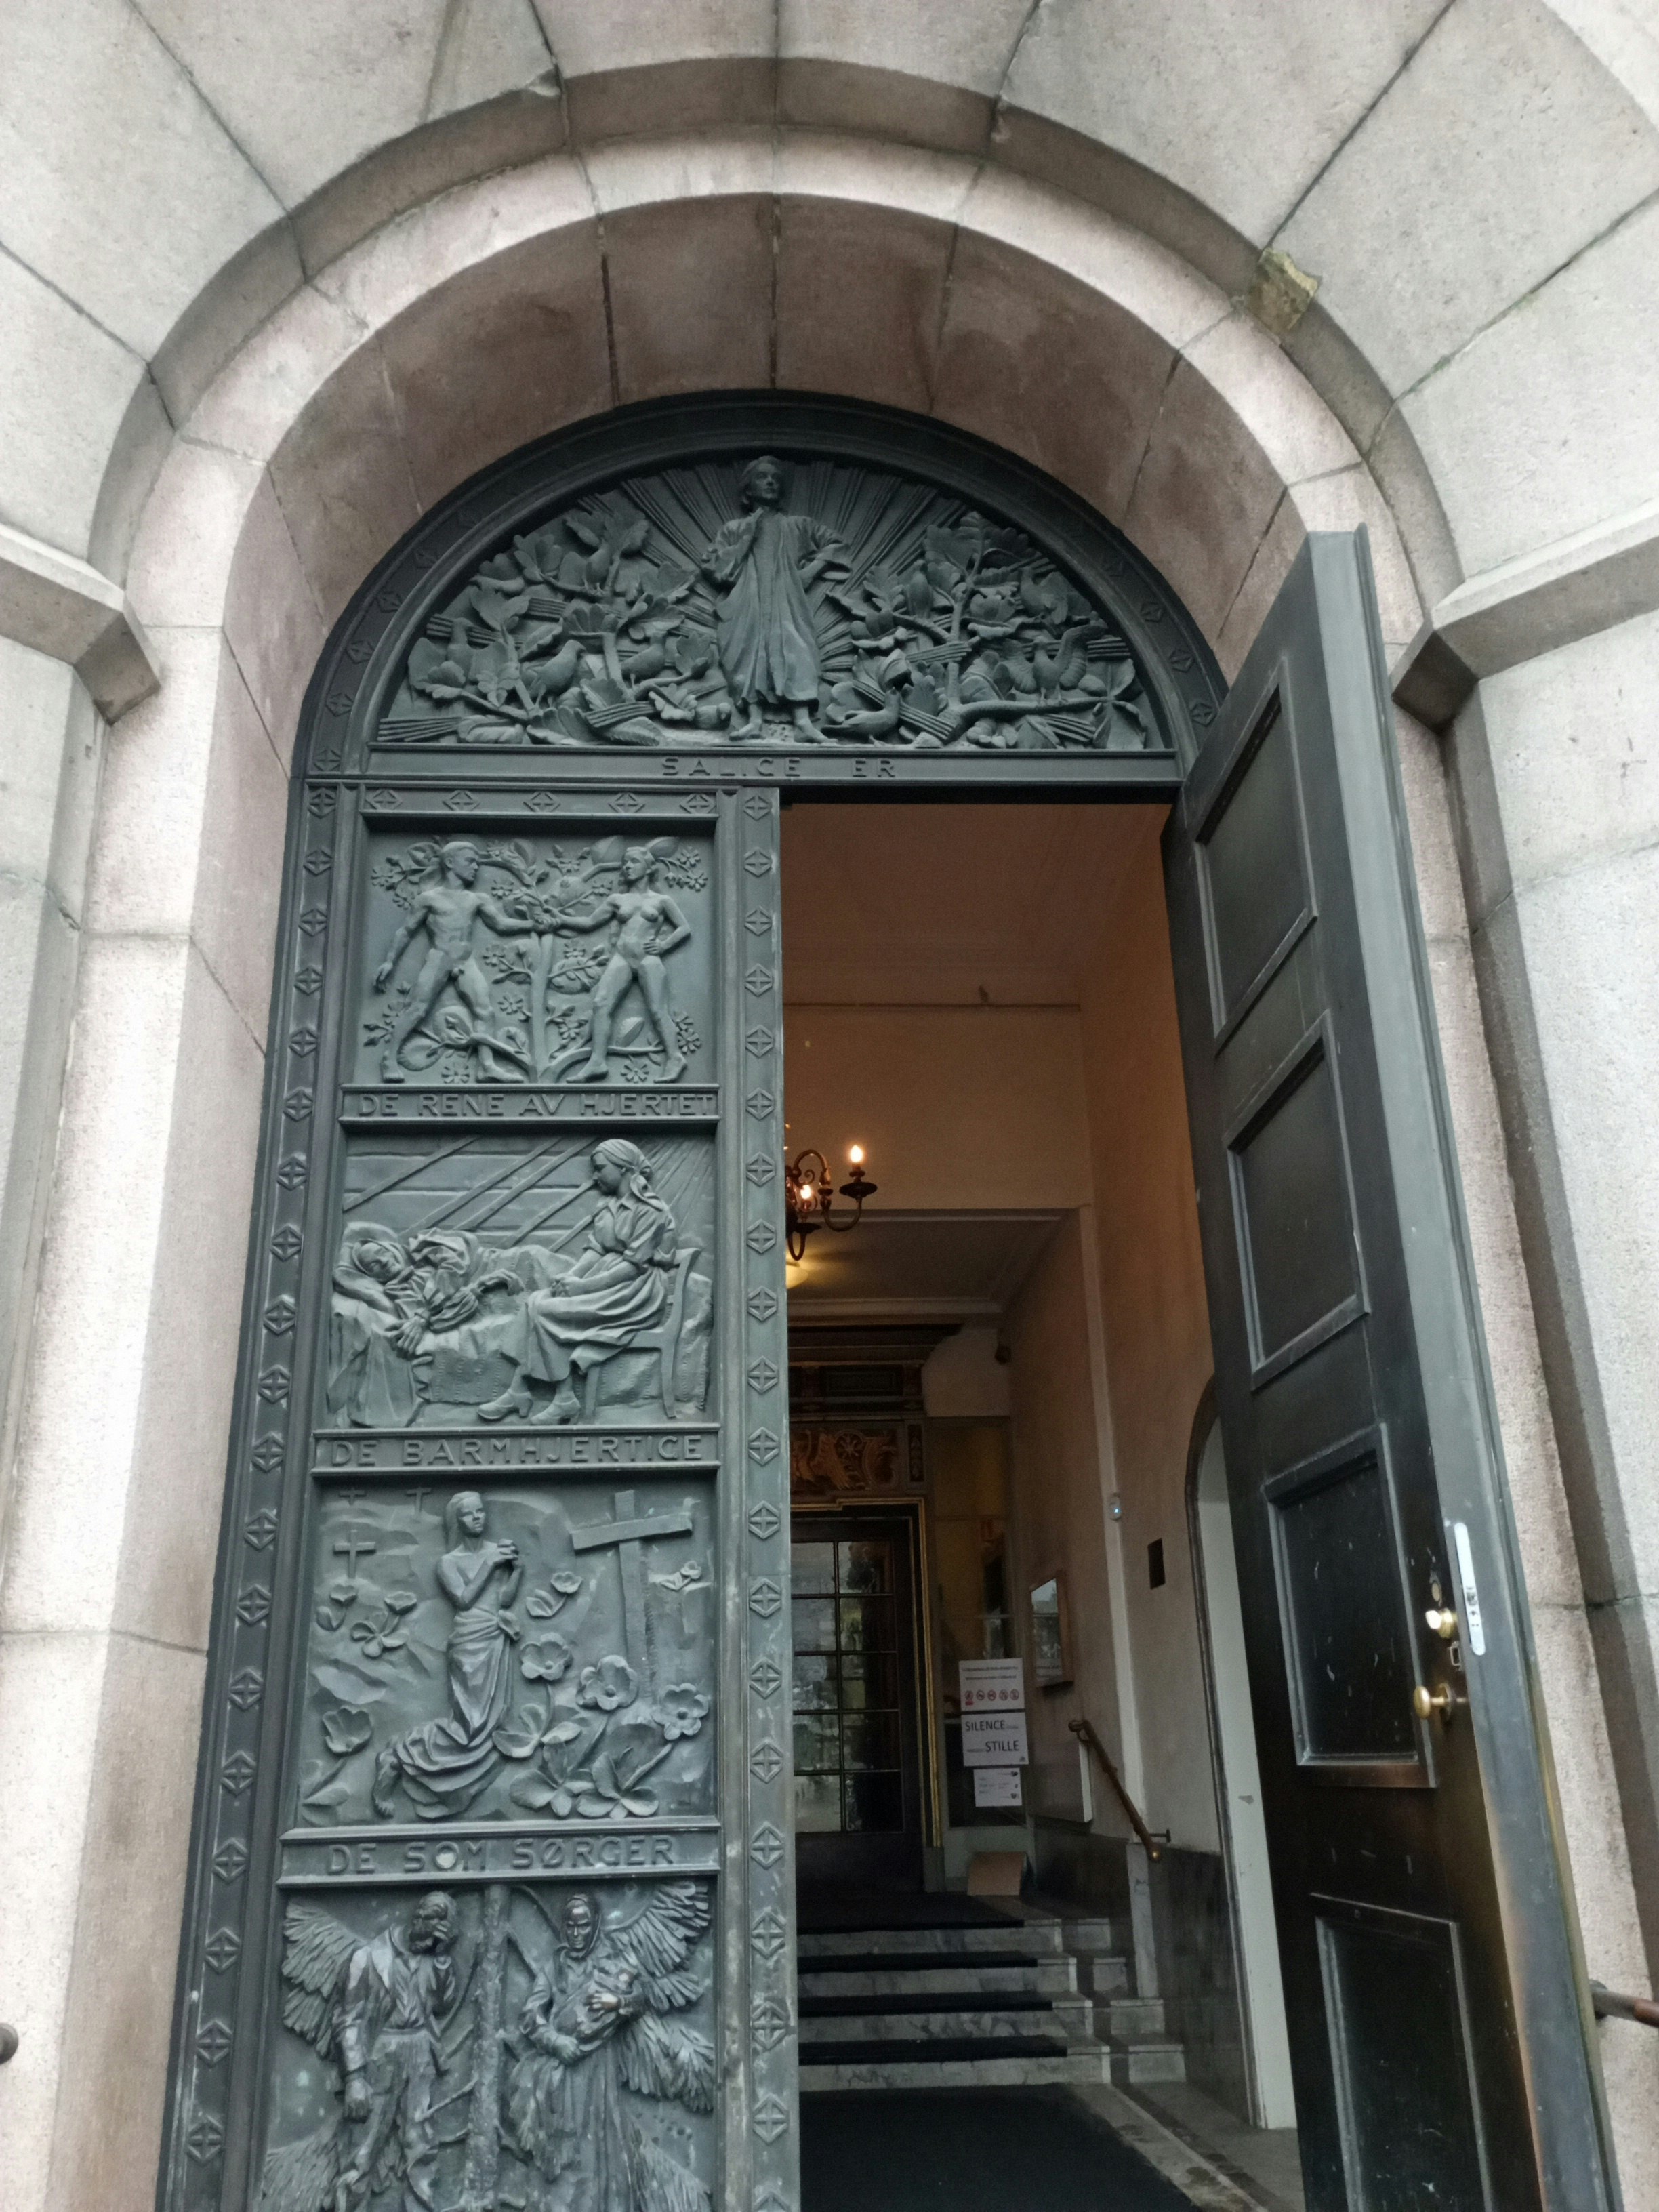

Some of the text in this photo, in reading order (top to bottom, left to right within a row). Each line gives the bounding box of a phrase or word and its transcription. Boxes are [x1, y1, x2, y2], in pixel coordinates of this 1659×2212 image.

[852, 758, 896, 778] ER
[358, 1092, 714, 1118] DE RENE AV HJERTET
[331, 1440, 378, 1467] DE
[965, 1719, 1006, 1732] SILENCE
[985, 1740, 1020, 1752] STILLE
[327, 1834, 674, 1875] DE SOM SØRGER
